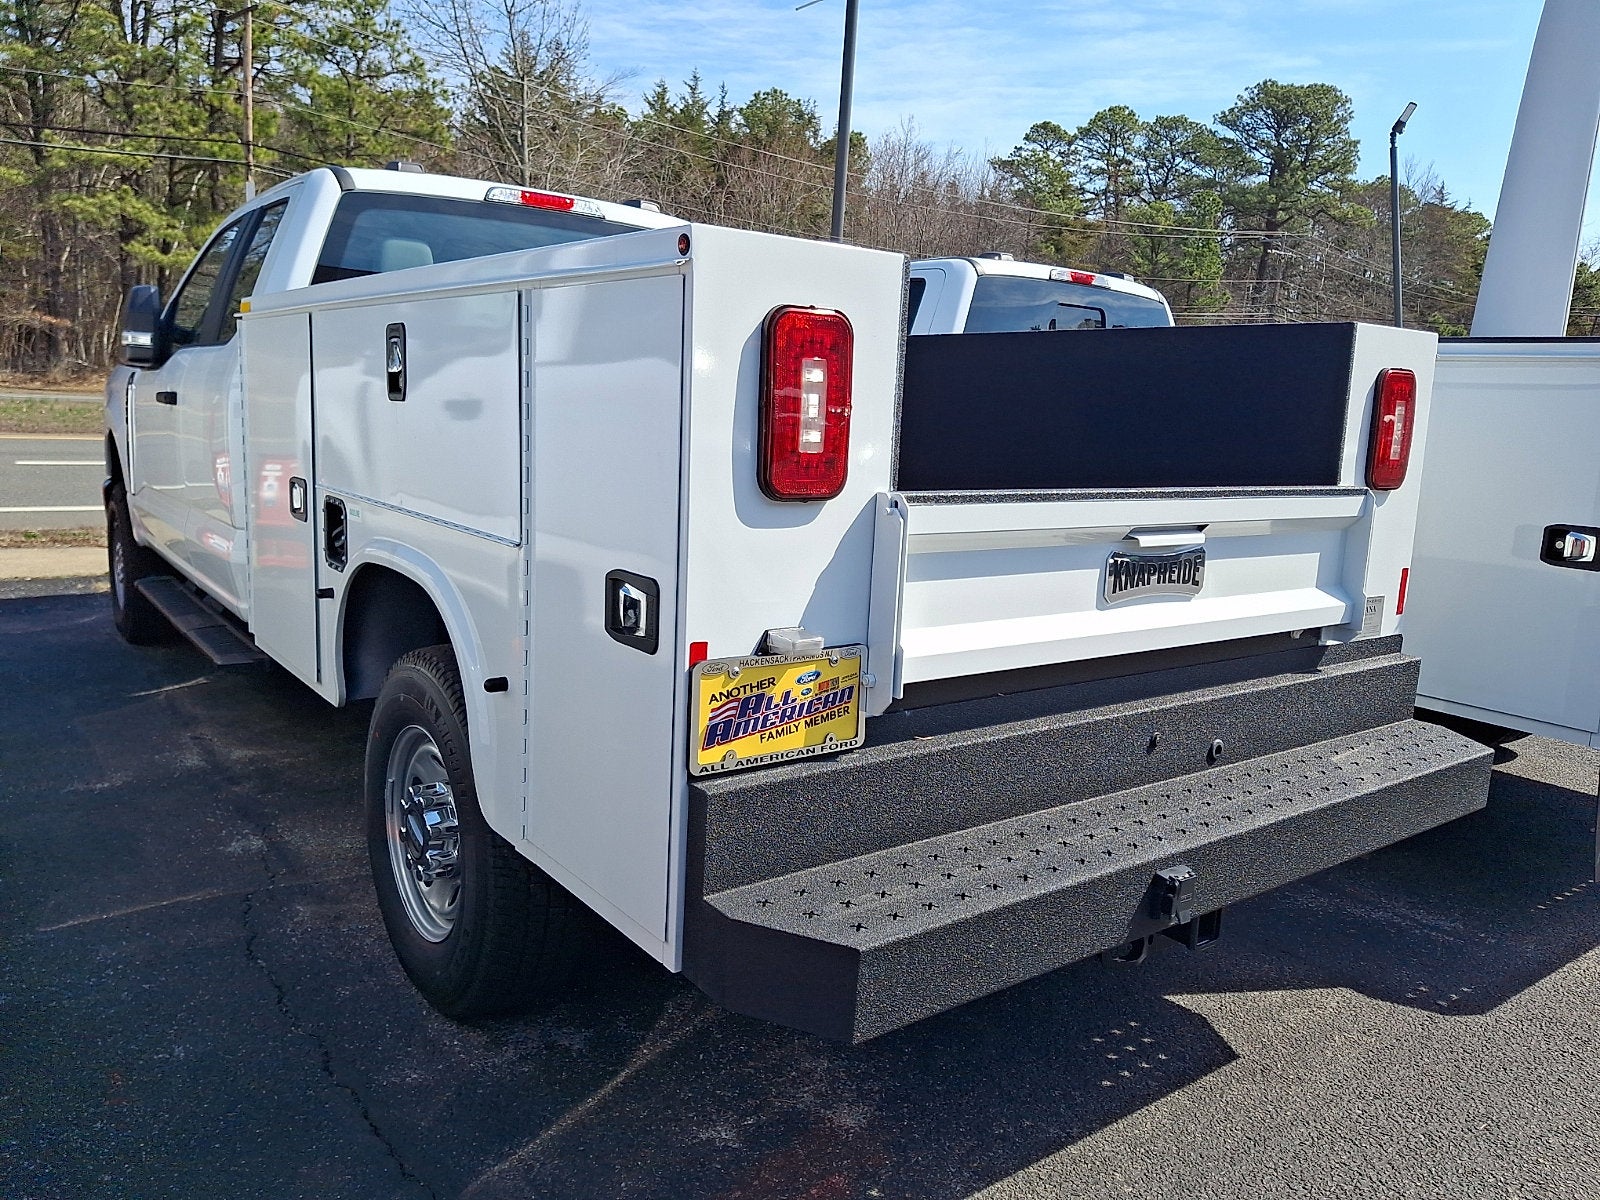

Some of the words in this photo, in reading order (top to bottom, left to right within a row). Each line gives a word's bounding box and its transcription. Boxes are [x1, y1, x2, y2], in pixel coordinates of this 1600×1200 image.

[1109, 555, 1202, 594] KNAPHEIDE
[739, 654, 789, 667] HACKENSACK
[709, 677, 776, 705] ANOTHER
[736, 690, 797, 720] ALL
[702, 686, 855, 749] AMERICAN
[760, 722, 802, 743] FAMILY
[804, 706, 850, 729] MEMBER
[699, 761, 733, 774] ALL
[734, 748, 816, 767] AMERICAN
[820, 739, 858, 753] FORD
